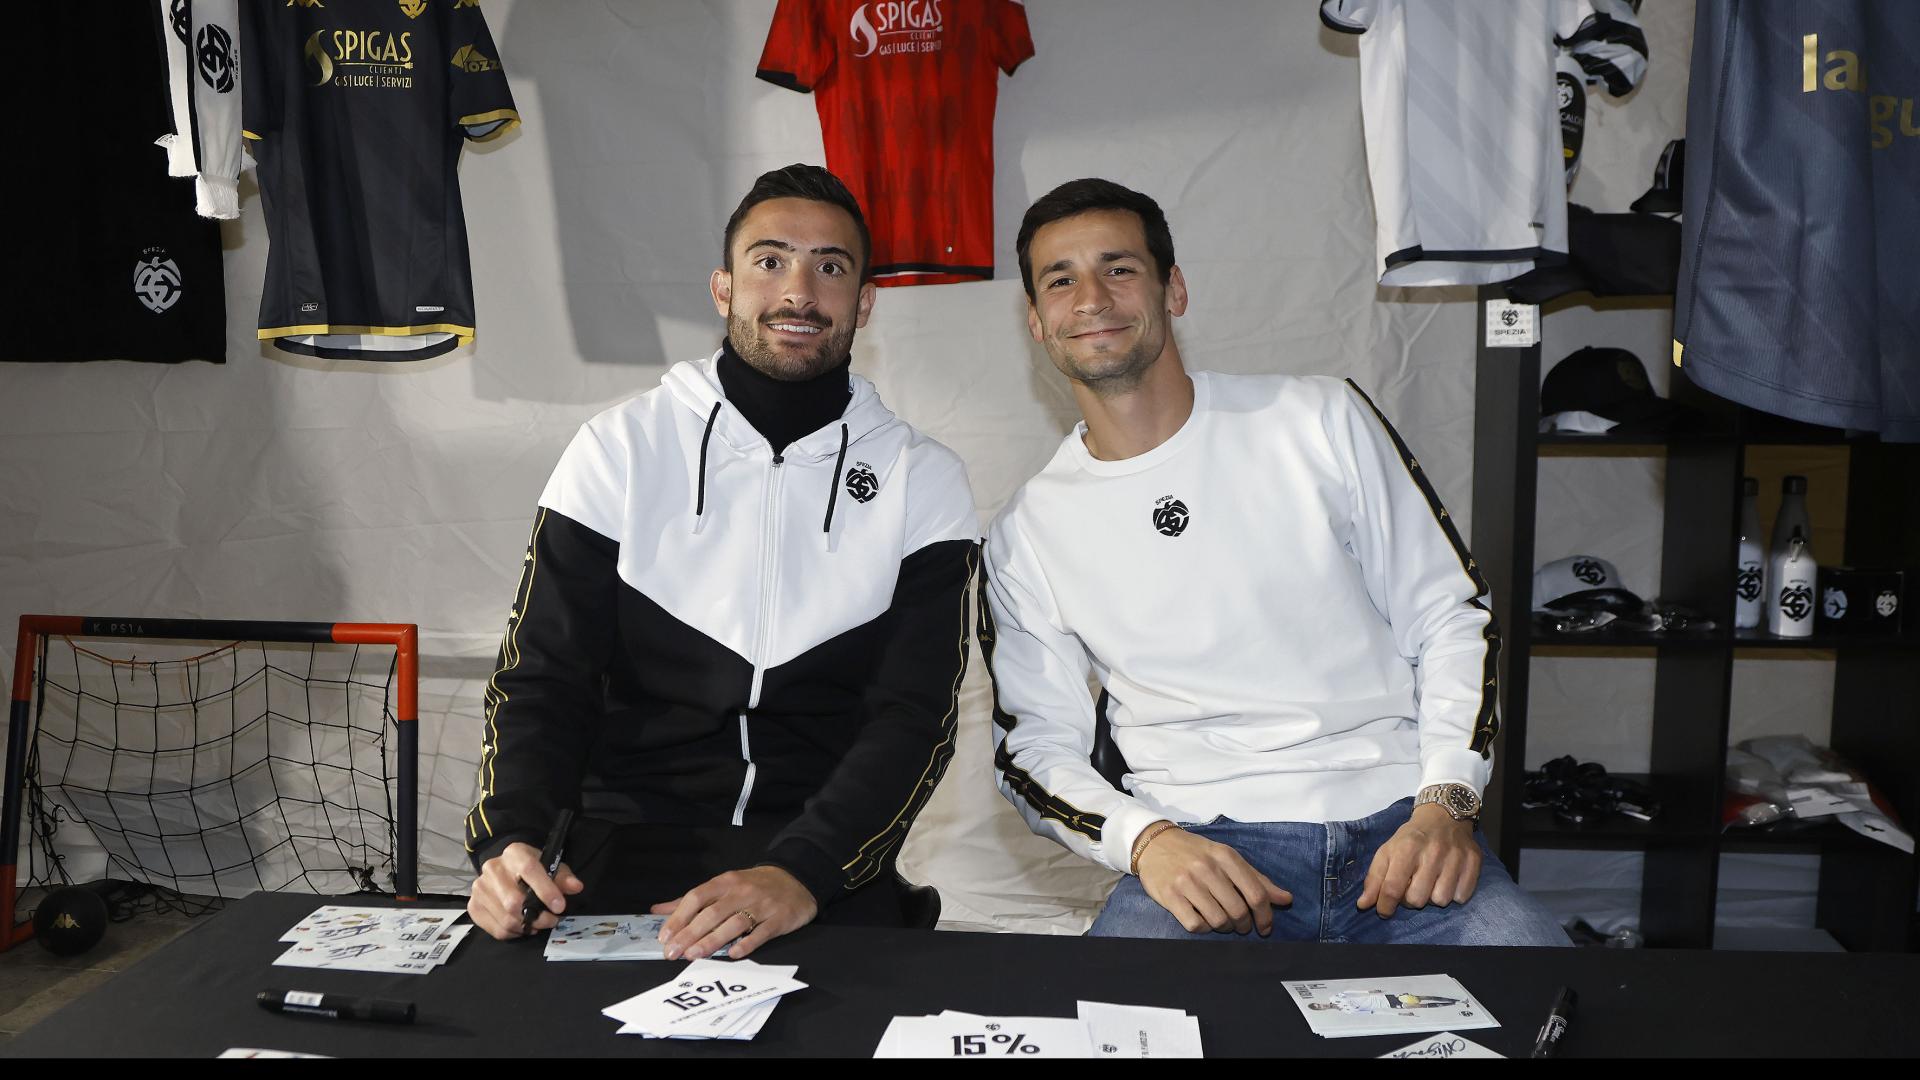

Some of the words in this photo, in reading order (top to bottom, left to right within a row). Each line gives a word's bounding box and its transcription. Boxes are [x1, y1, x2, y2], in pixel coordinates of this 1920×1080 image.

[876, 0, 942, 31] SPIGAS
[333, 30, 412, 62] SPIGAS
[897, 41, 915, 53] LUCE
[369, 65, 402, 75] CLIENTI
[353, 75, 374, 87] LUCE
[381, 76, 412, 88] SERVIZI
[1494, 328, 1527, 336] SPEZIA
[663, 980, 747, 1011] 15%
[951, 1034, 1041, 1056] 15%
